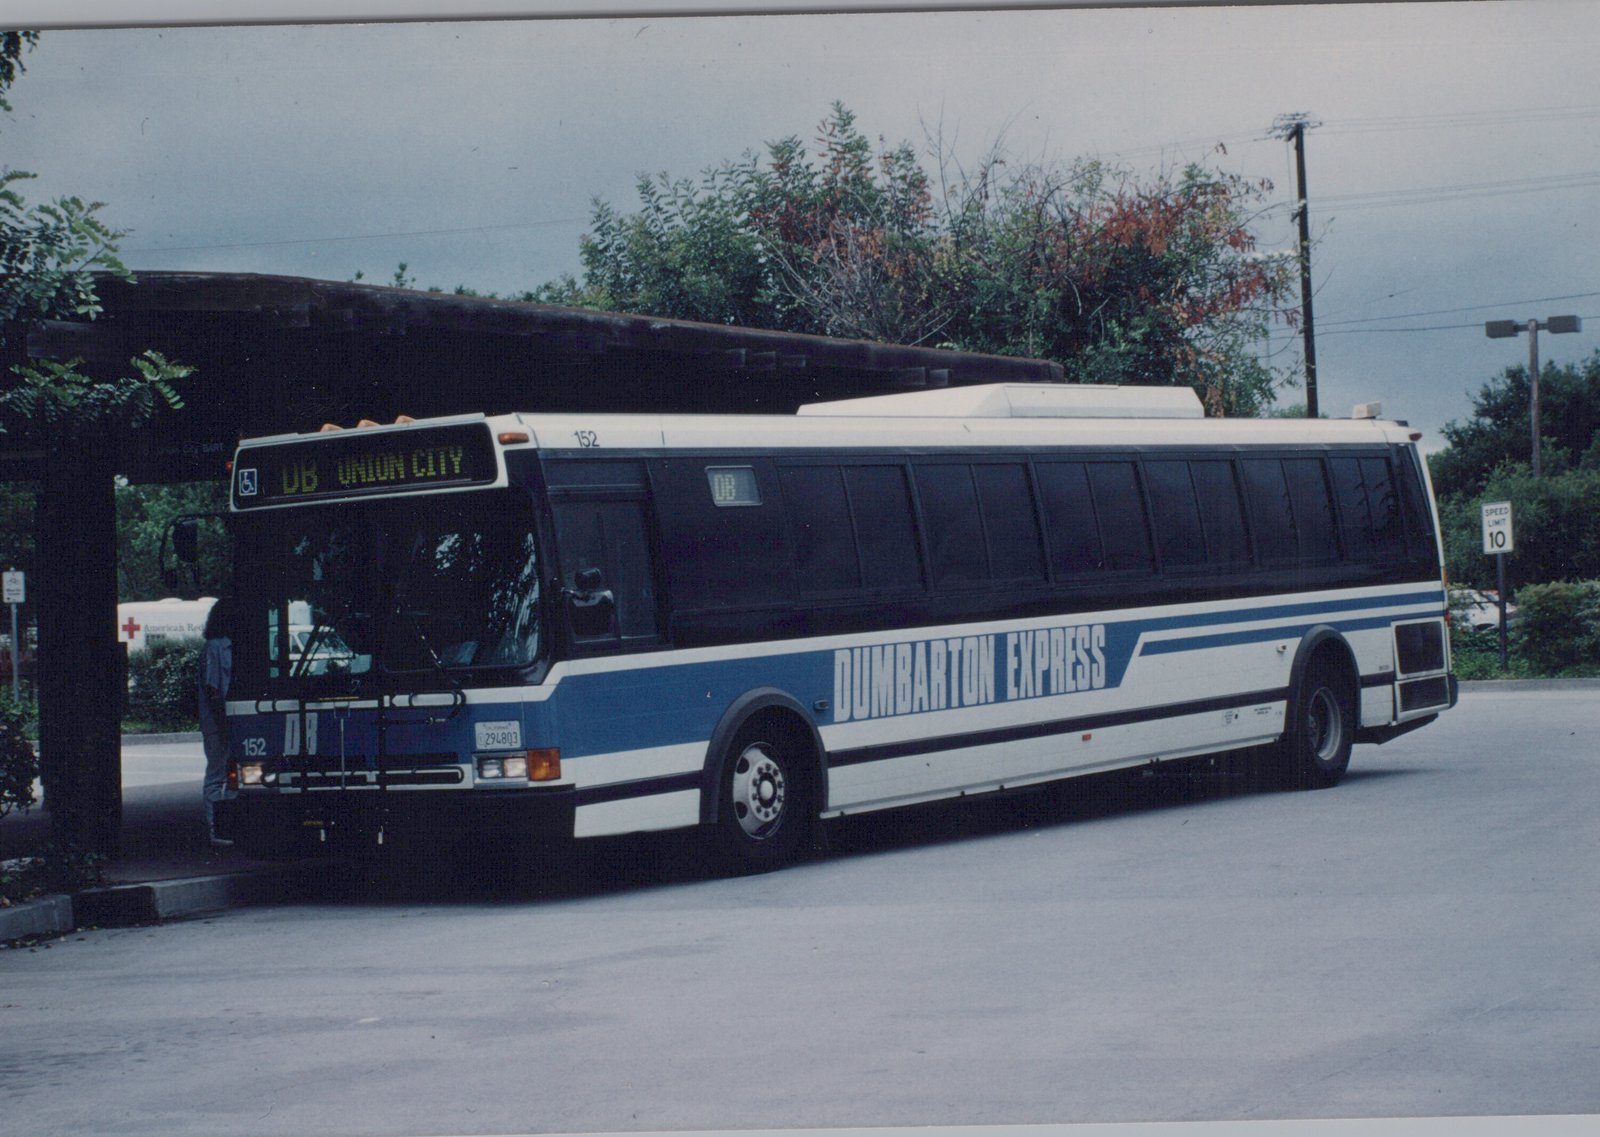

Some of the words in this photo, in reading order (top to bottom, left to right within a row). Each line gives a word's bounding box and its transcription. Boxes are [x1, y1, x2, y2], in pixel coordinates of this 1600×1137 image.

[203, 442, 225, 452] BART
[574, 430, 600, 448] 152
[282, 455, 318, 494] DB
[338, 452, 405, 484] UNION
[410, 446, 463, 477] CITY
[714, 474, 736, 500] DB
[1485, 507, 1509, 517] SPEED
[1488, 518, 1506, 527] LIMIT
[1489, 530, 1506, 549] 10
[144, 623, 184, 632] American
[834, 635, 995, 722] DUMBARTON
[1007, 624, 1106, 700] EXPRESS
[242, 738, 267, 756] 152
